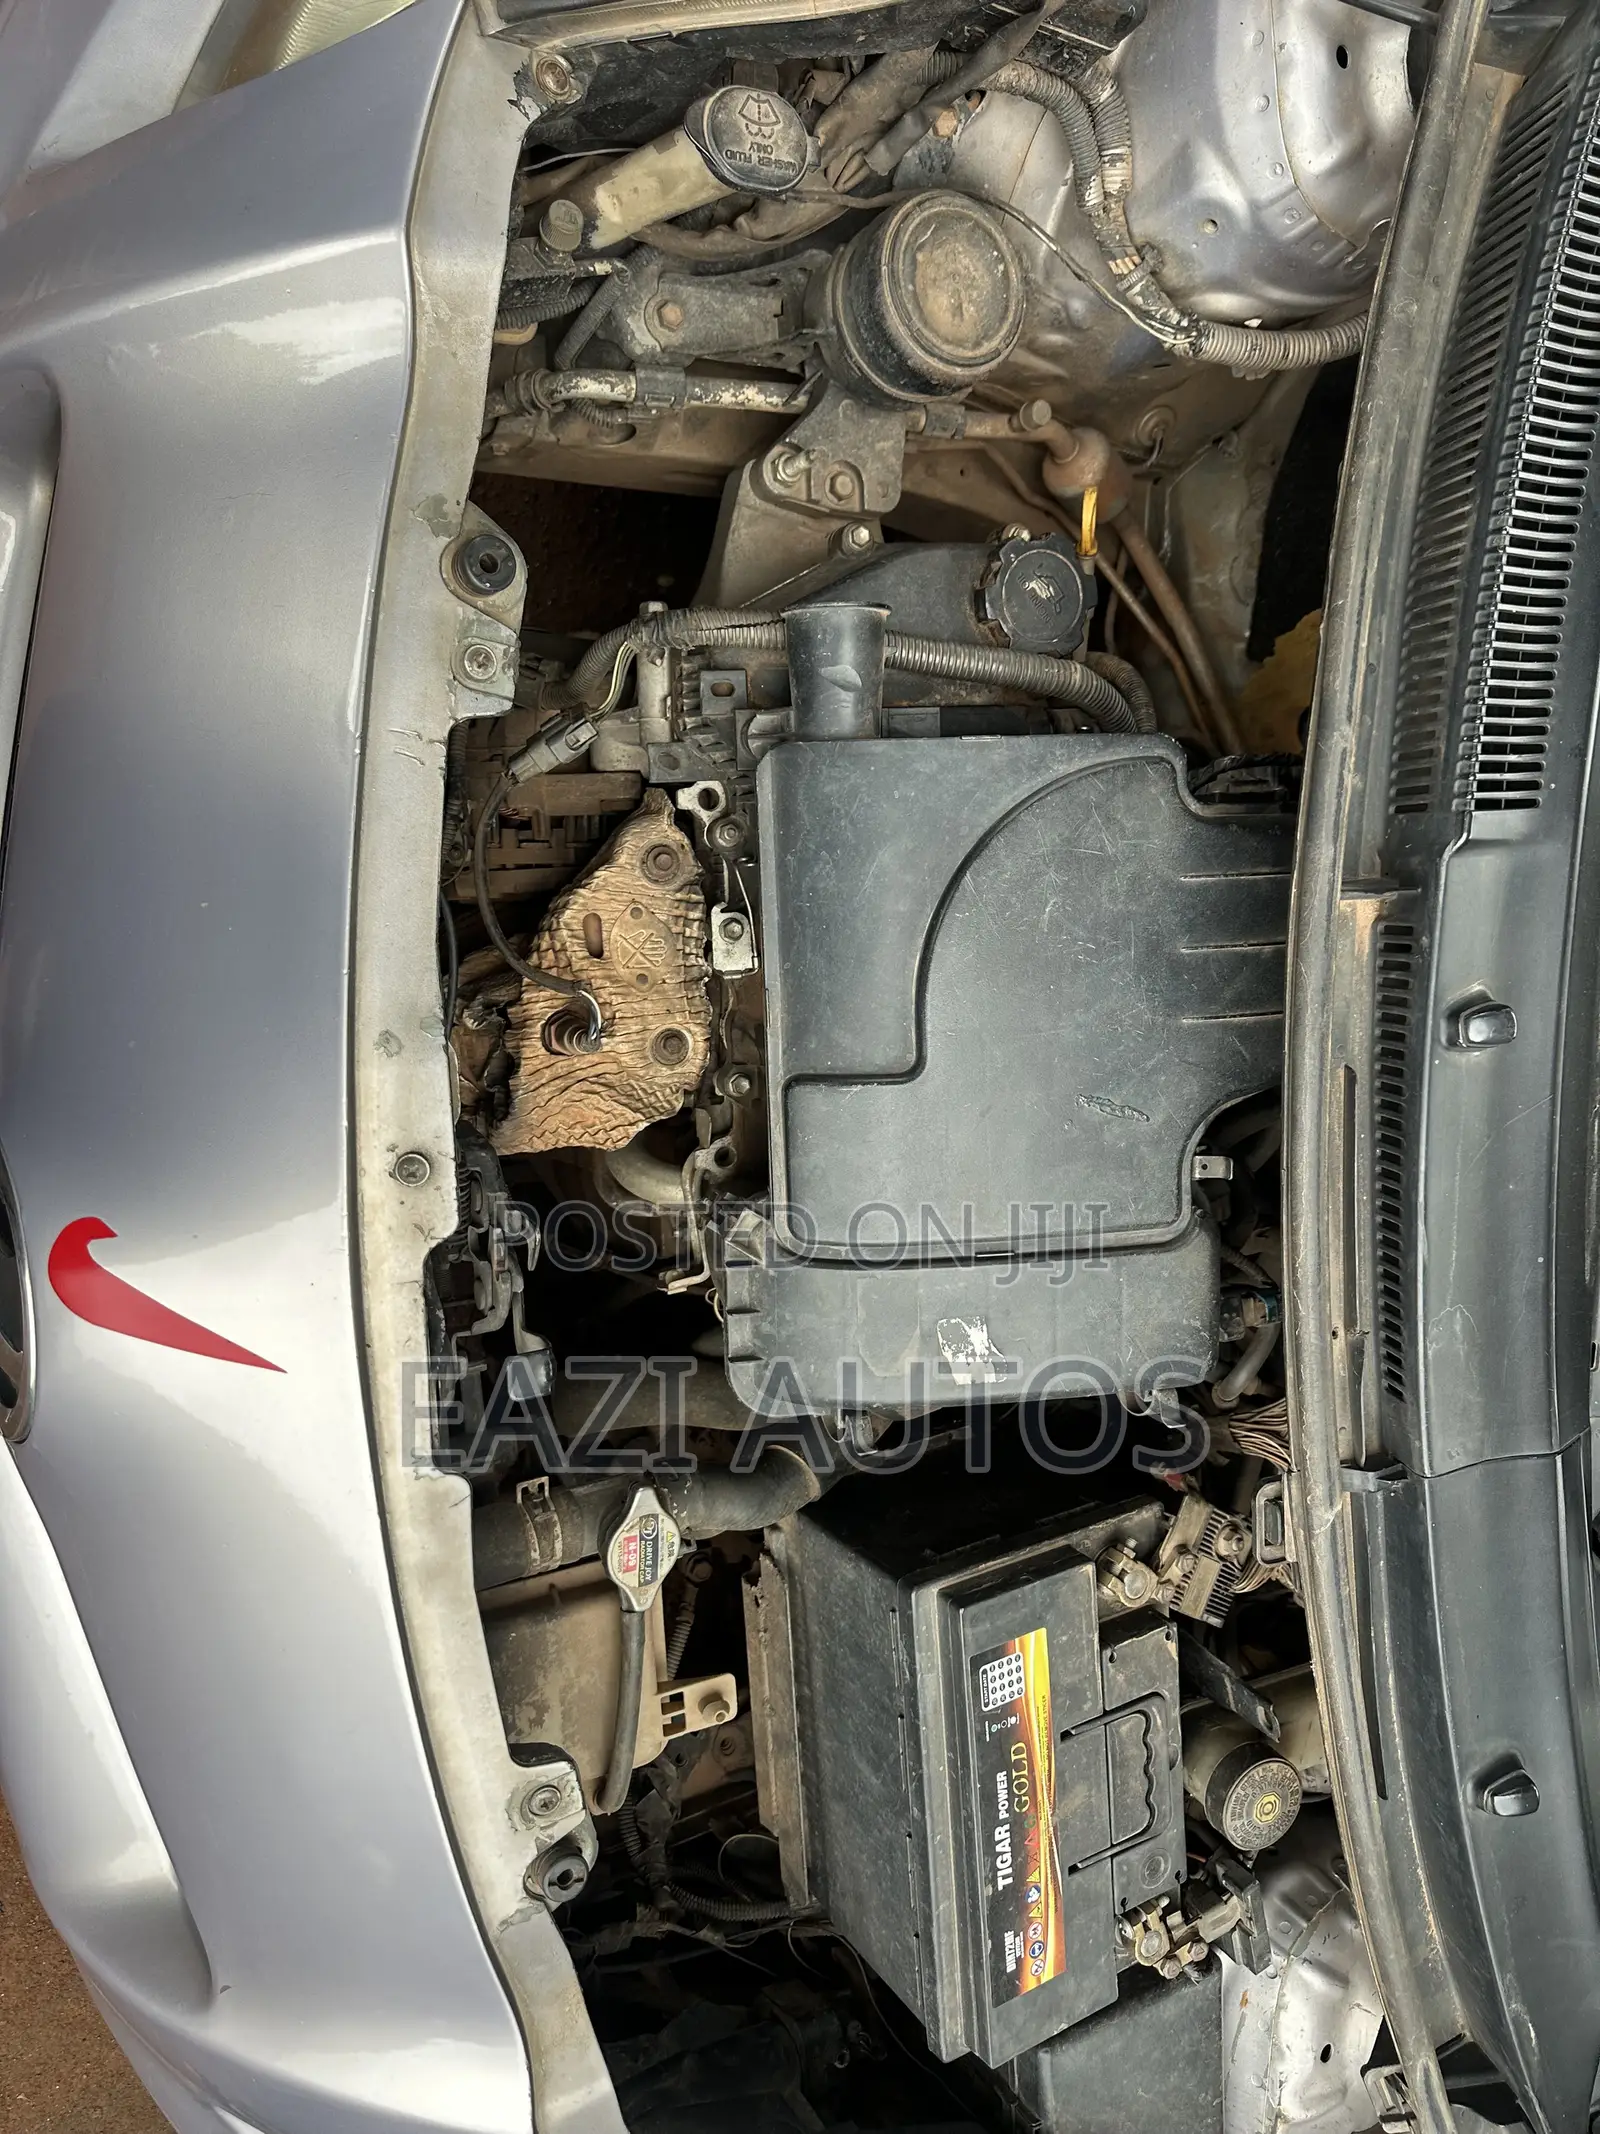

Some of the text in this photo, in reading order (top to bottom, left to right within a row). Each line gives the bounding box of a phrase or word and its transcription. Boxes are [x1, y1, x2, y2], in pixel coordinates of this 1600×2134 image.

[725, 149, 798, 175] WASHER FLUID
[748, 141, 774, 156] ONLY
[645, 1541, 653, 1581] DRIVE JOY
[1009, 1741, 1031, 1813] GOLD
[994, 1771, 1014, 1891] TIGAR POWER
